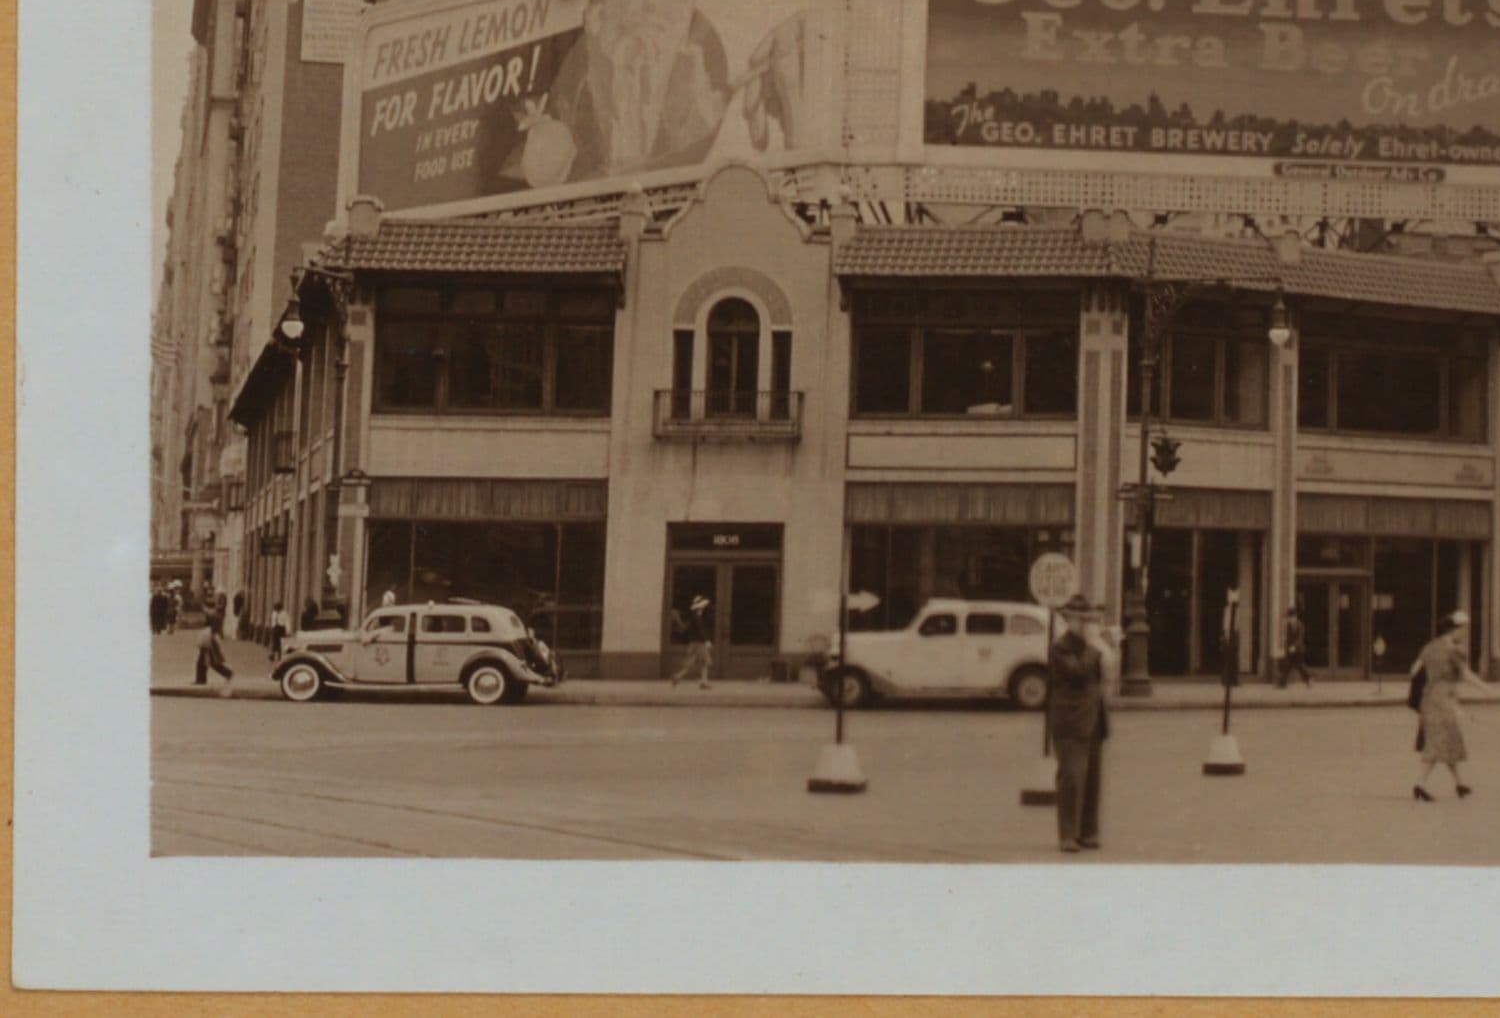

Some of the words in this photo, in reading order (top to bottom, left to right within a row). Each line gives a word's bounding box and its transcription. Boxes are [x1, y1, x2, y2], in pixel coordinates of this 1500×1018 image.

[373, 28, 447, 79] FRESH
[1020, 11, 1228, 68] Extra
[1259, 21, 1429, 73] Beer
[370, 91, 415, 136] FOR
[428, 44, 541, 124] FLAVOR!
[1362, 77, 1419, 118] On
[415, 133, 433, 152] IN
[434, 120, 479, 150] EVERY
[951, 102, 994, 136] The
[981, 121, 1041, 143] GEO.
[1053, 123, 1139, 146] EHRET
[1151, 127, 1273, 152] BREWERY
[1291, 133, 1365, 158] Solely
[414, 154, 448, 182] FOOD
[451, 149, 474, 174] USE
